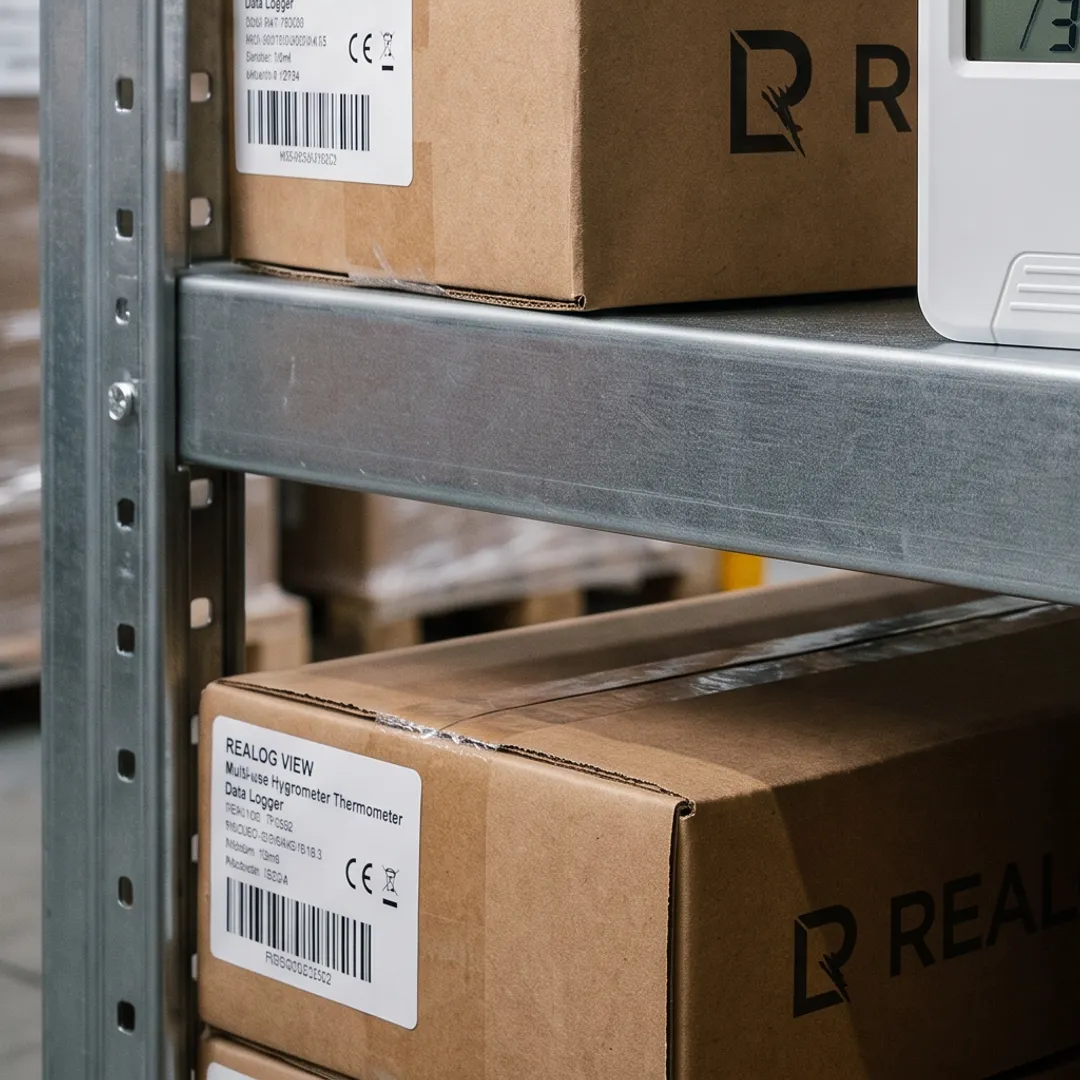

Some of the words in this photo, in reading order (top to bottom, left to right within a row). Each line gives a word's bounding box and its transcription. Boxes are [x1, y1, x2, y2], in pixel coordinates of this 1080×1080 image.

[226, 737, 277, 766] REALOG
[281, 752, 314, 777] VIEW
[225, 781, 246, 800] Data
[249, 789, 284, 812] Logger
[271, 774, 331, 804] Hygrometer
[333, 792, 403, 826] Thermometer
